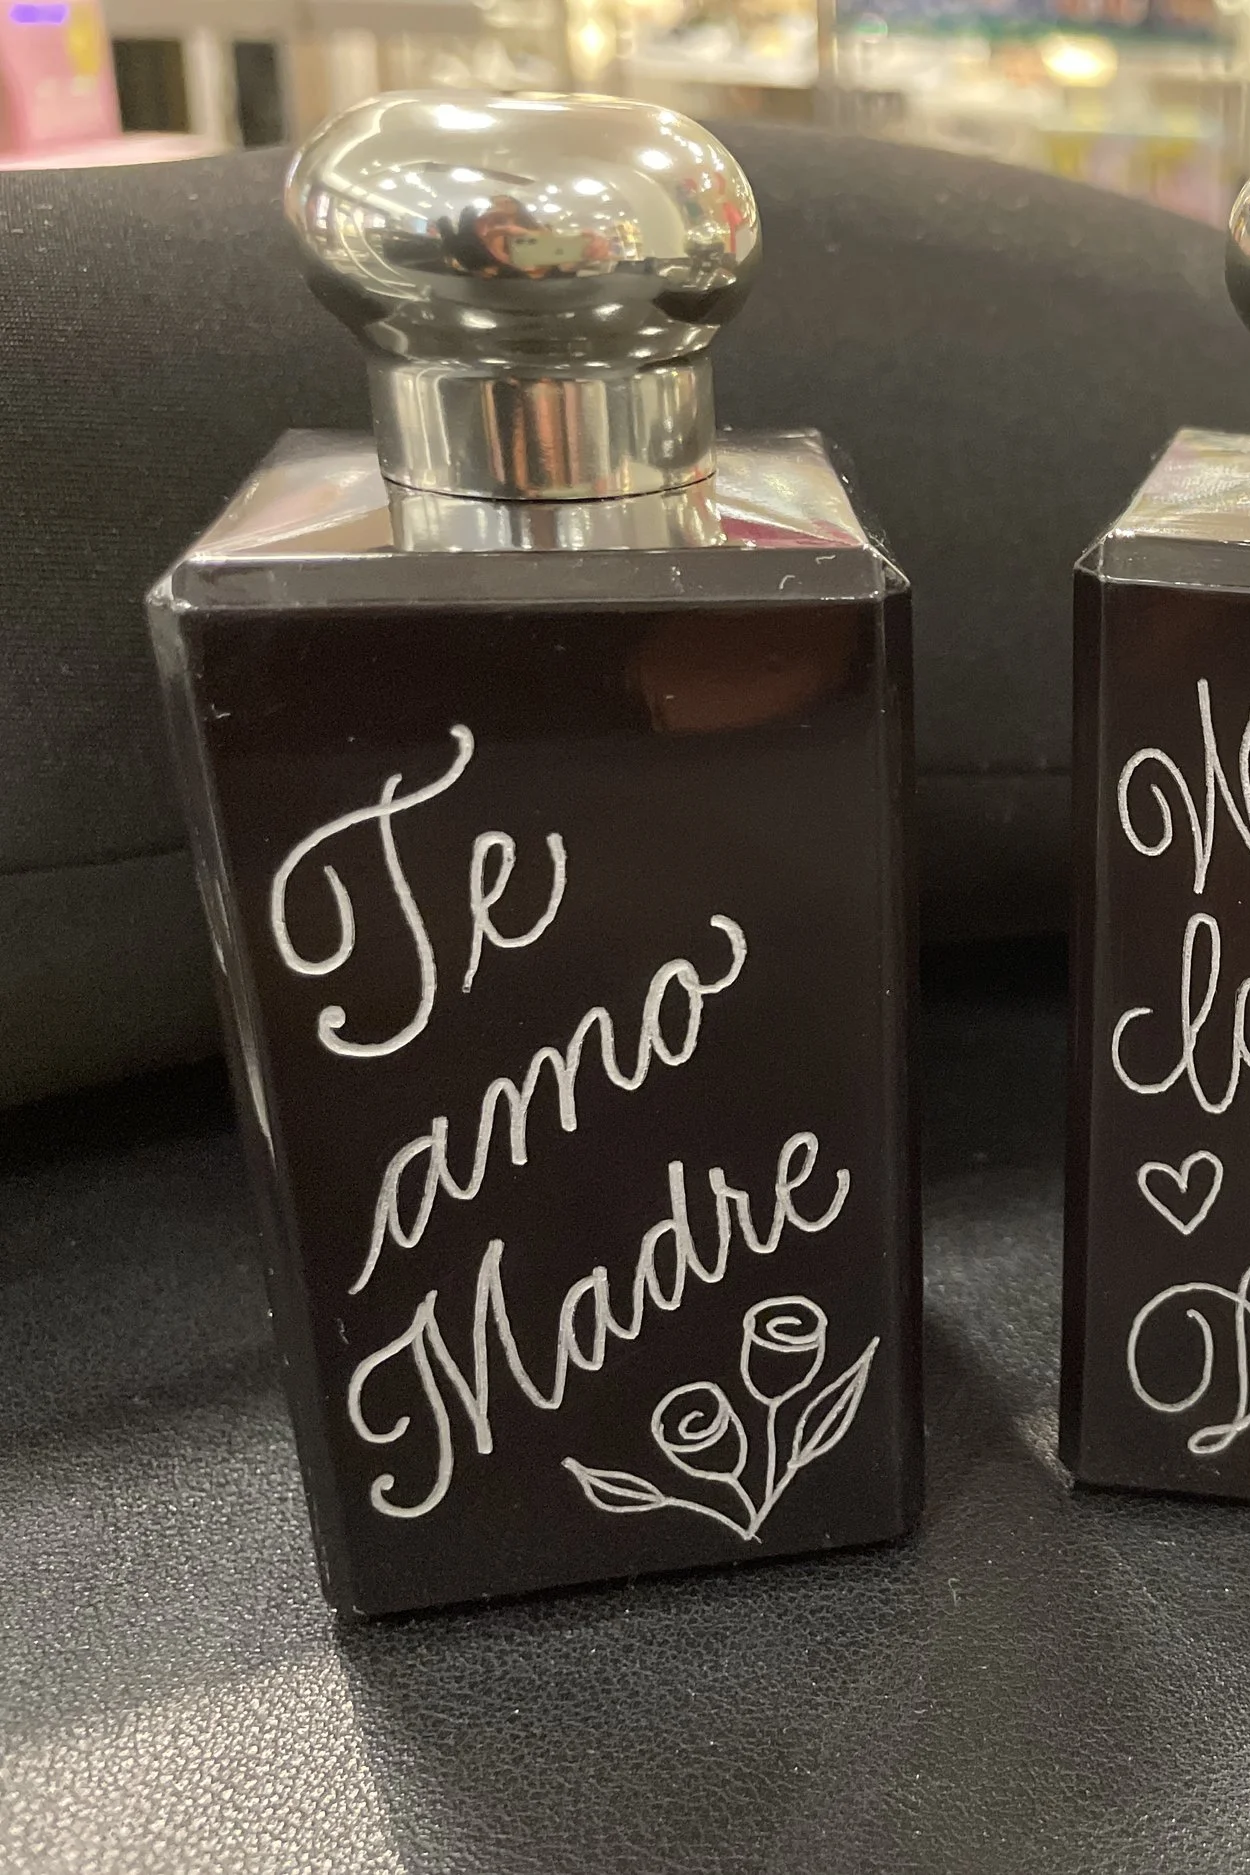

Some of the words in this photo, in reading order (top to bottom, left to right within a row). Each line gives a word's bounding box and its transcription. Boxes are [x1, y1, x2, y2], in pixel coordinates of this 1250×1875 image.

[271, 722, 568, 1057] Te
[348, 914, 747, 1295] amo
[347, 1130, 851, 1518] Madre
